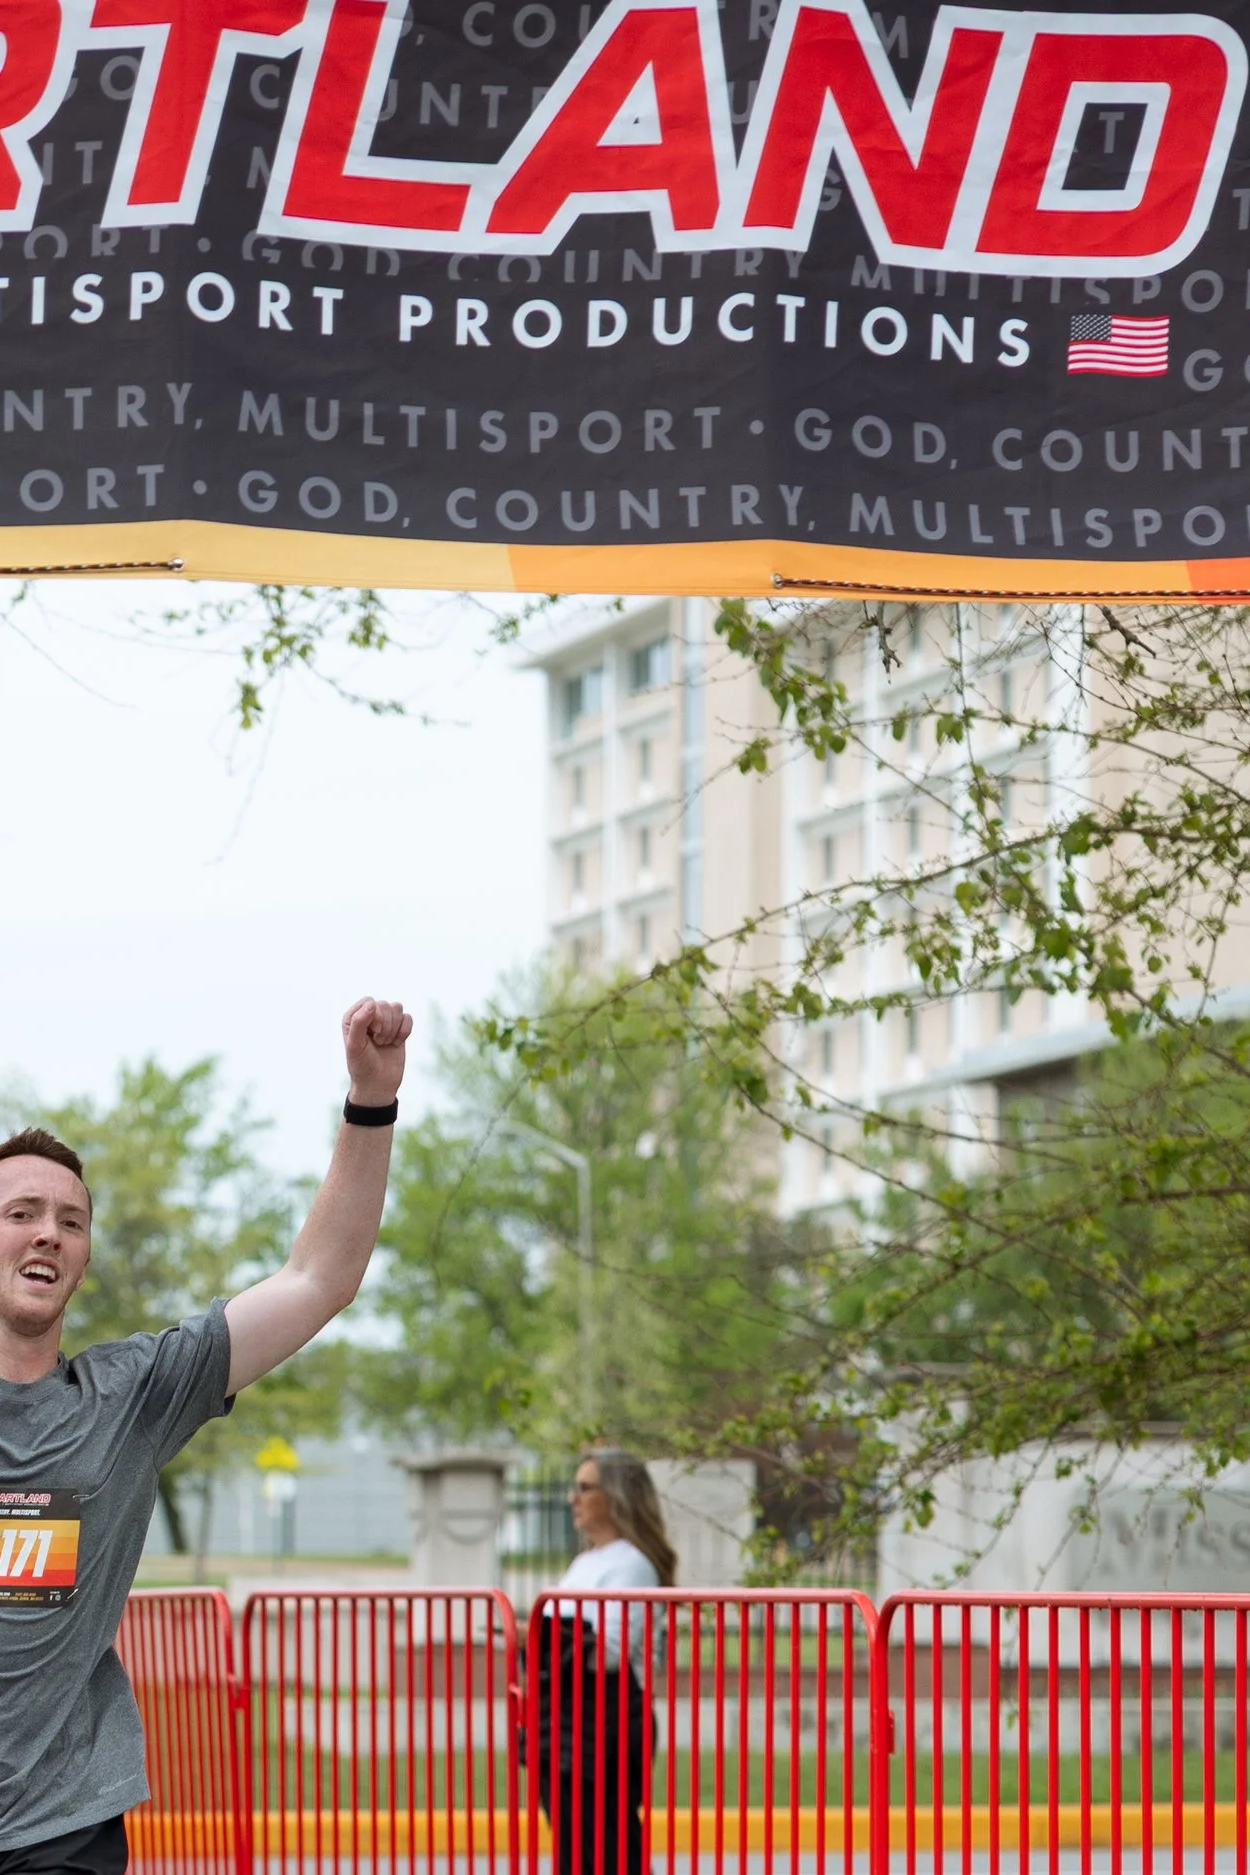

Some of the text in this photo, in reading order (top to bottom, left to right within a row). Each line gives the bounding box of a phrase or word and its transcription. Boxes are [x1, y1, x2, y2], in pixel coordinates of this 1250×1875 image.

[398, 292, 1030, 368] PRODUCTIONS
[238, 391, 721, 454] MULTISPORT
[795, 407, 958, 470] GOD,
[992, 427, 1249, 473] COUNT
[239, 470, 410, 528] GOD,
[446, 485, 816, 533] COUNTRY,
[850, 493, 1250, 549] MULTISPO
